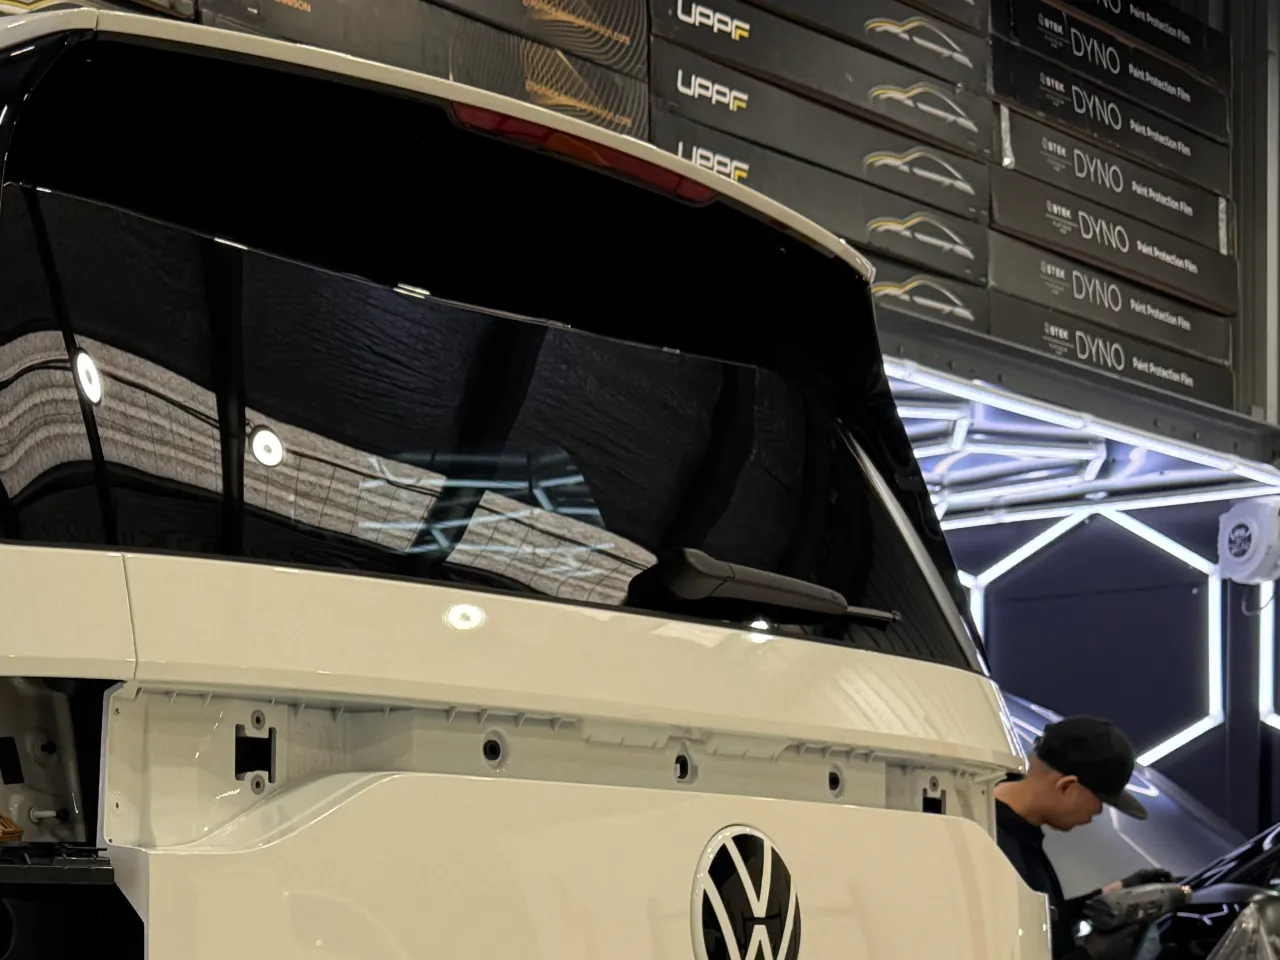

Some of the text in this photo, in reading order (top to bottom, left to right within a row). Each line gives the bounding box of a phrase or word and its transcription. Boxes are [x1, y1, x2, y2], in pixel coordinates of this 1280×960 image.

[677, 0, 751, 41] UPPF
[1071, 27, 1120, 74] DYNO
[676, 68, 749, 112] UPPF
[1072, 85, 1122, 130] DYNO
[1074, 149, 1124, 193] DYNO
[1078, 210, 1129, 253] DYNO
[1072, 270, 1122, 312] DYNO
[1075, 330, 1125, 371] DYNO
